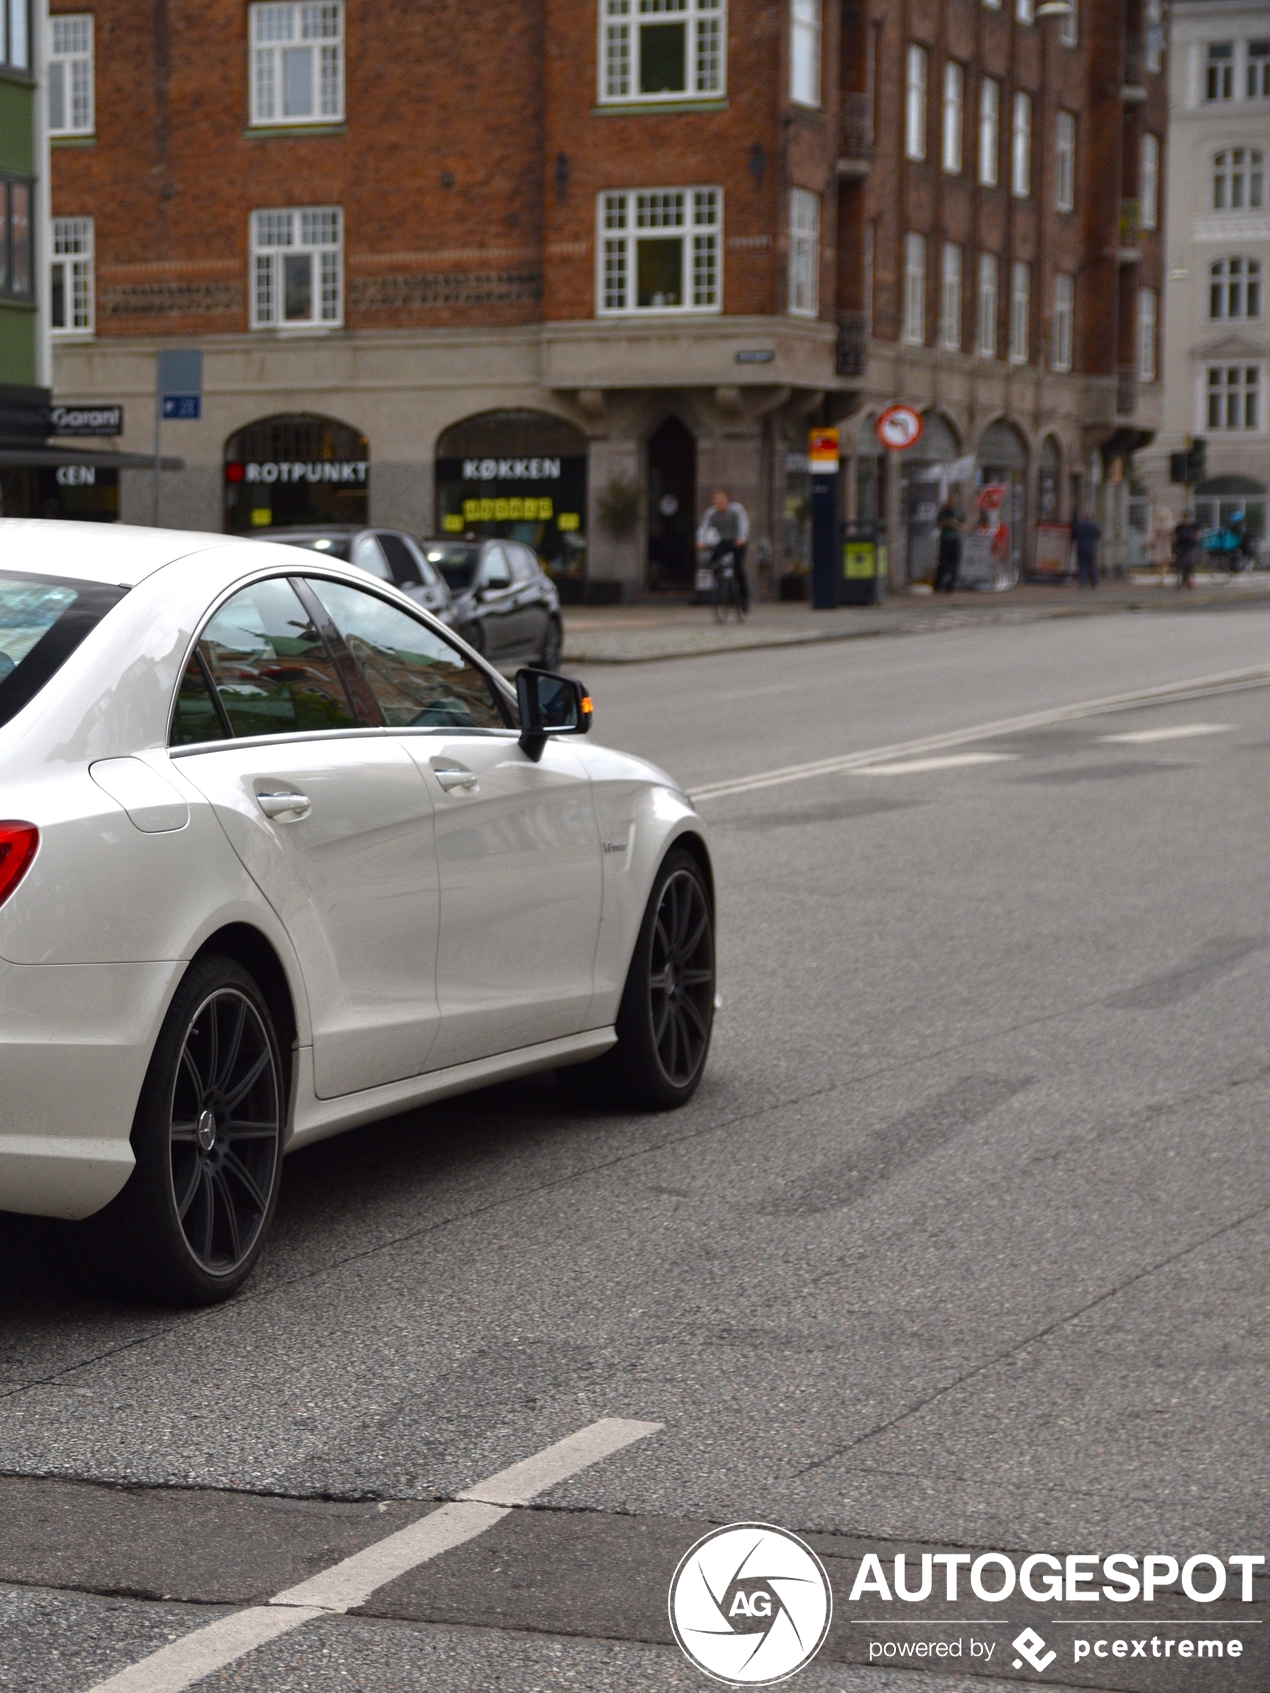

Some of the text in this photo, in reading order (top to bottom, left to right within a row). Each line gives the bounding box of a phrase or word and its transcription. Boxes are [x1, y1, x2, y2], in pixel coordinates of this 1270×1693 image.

[51, 408, 119, 427] Garant
[245, 461, 369, 483] ROTPUNKT
[462, 458, 561, 481] KØKKEN
